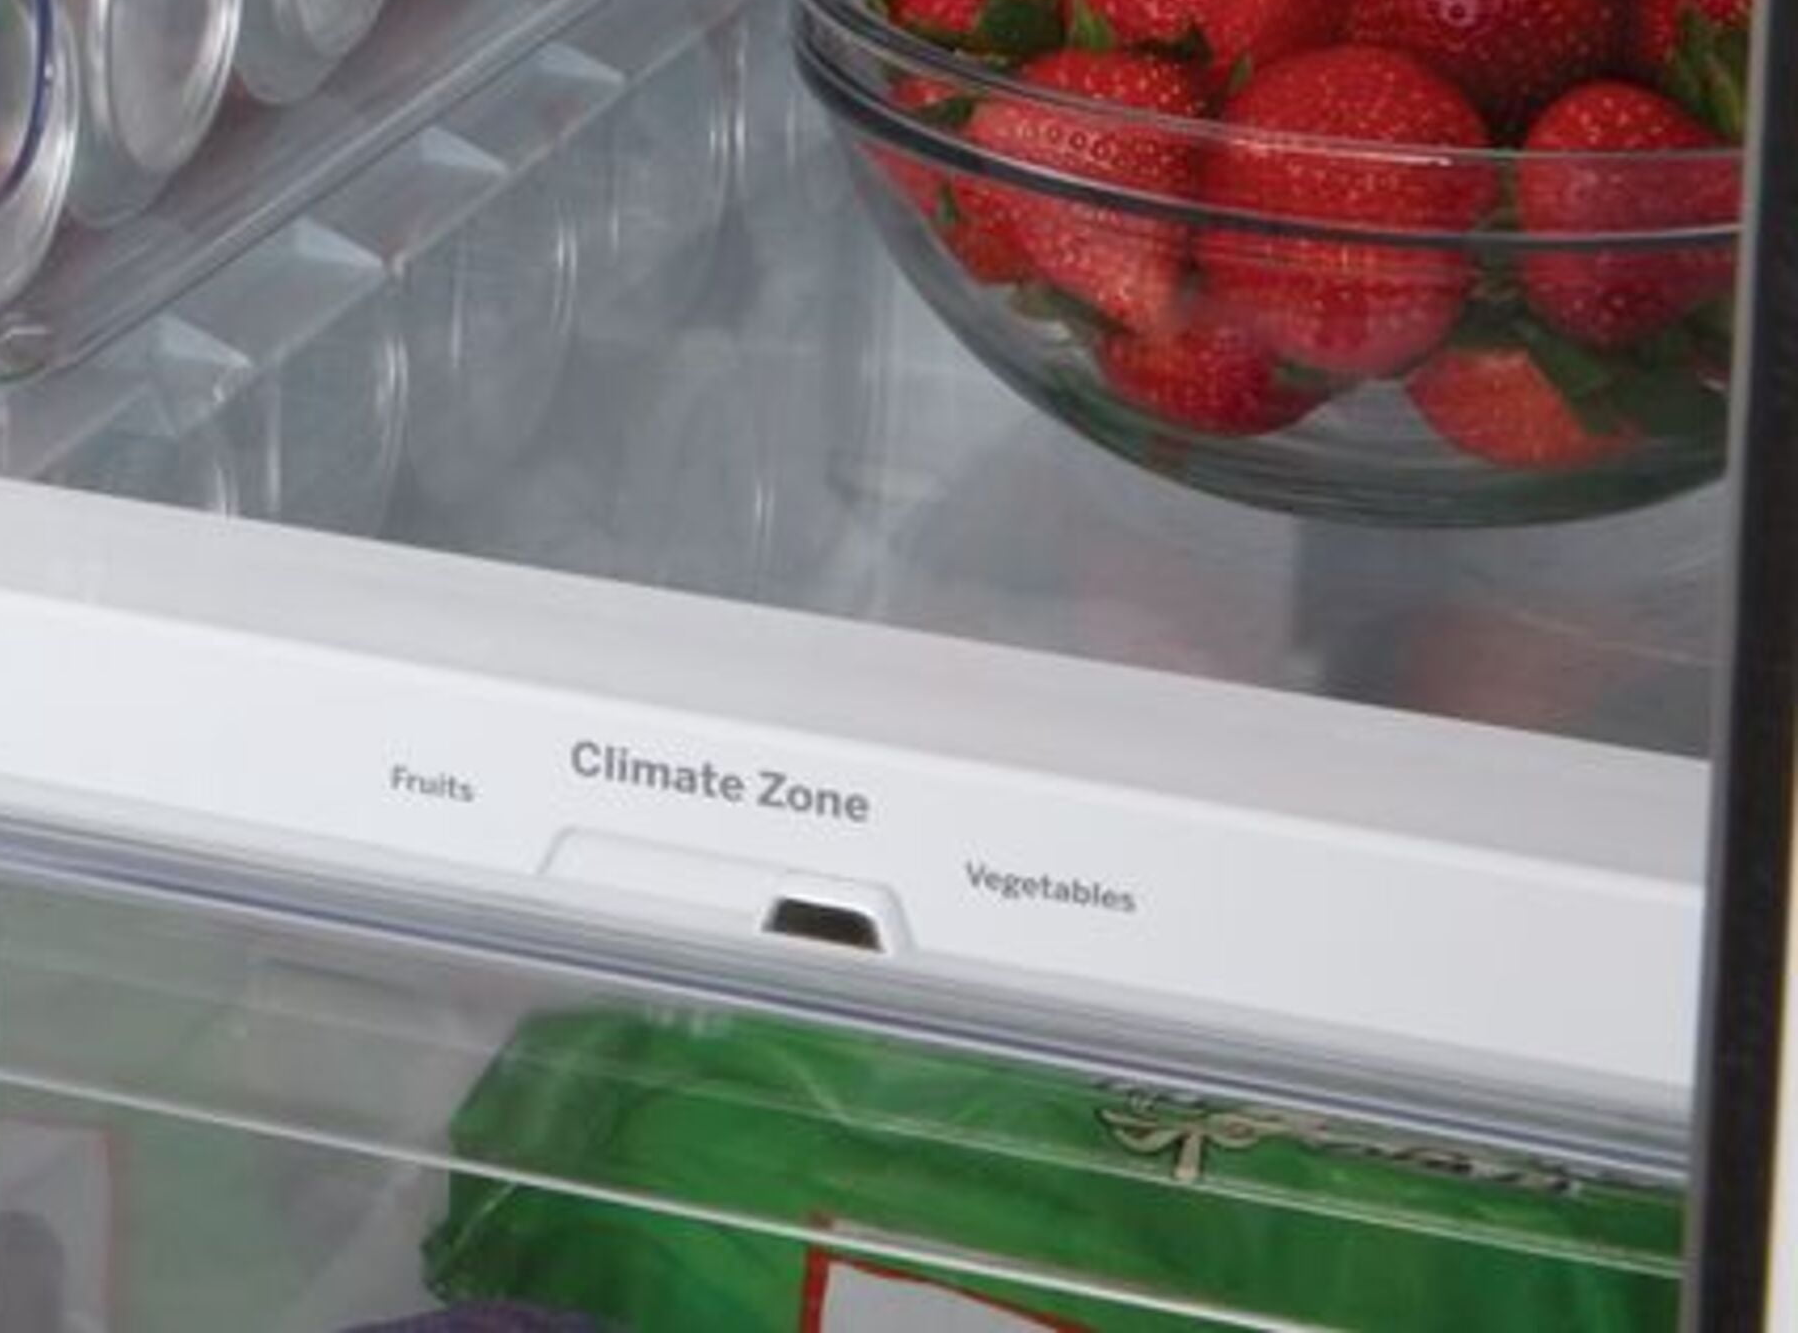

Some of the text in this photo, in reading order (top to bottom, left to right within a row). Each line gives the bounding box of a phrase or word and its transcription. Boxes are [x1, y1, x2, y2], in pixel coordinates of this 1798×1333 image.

[390, 763, 476, 803] Fruits
[569, 738, 871, 824] Climate Zone
[964, 859, 1137, 916] Vegetables
